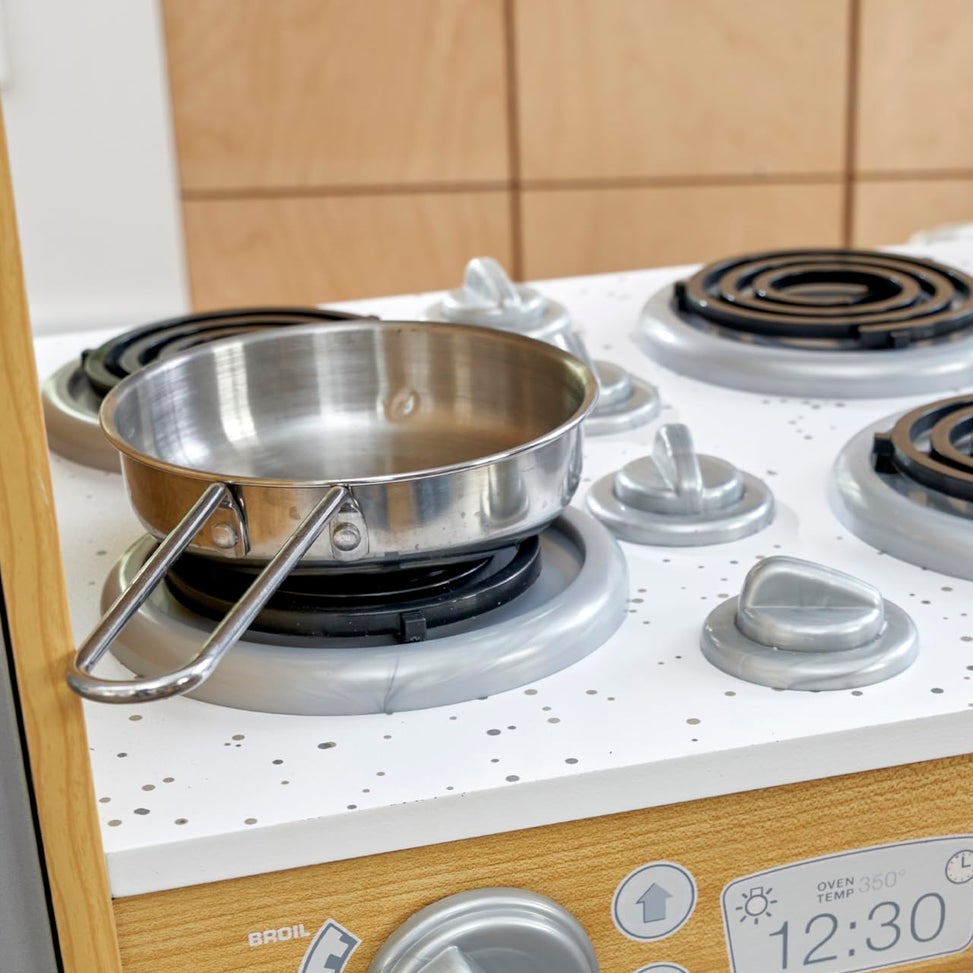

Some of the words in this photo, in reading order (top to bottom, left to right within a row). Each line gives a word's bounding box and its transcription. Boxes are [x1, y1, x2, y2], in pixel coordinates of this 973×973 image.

[817, 876, 855, 892] OVEN
[816, 888, 855, 904] TEMP
[248, 924, 311, 947] BROIL
[768, 892, 946, 970] 12:30
